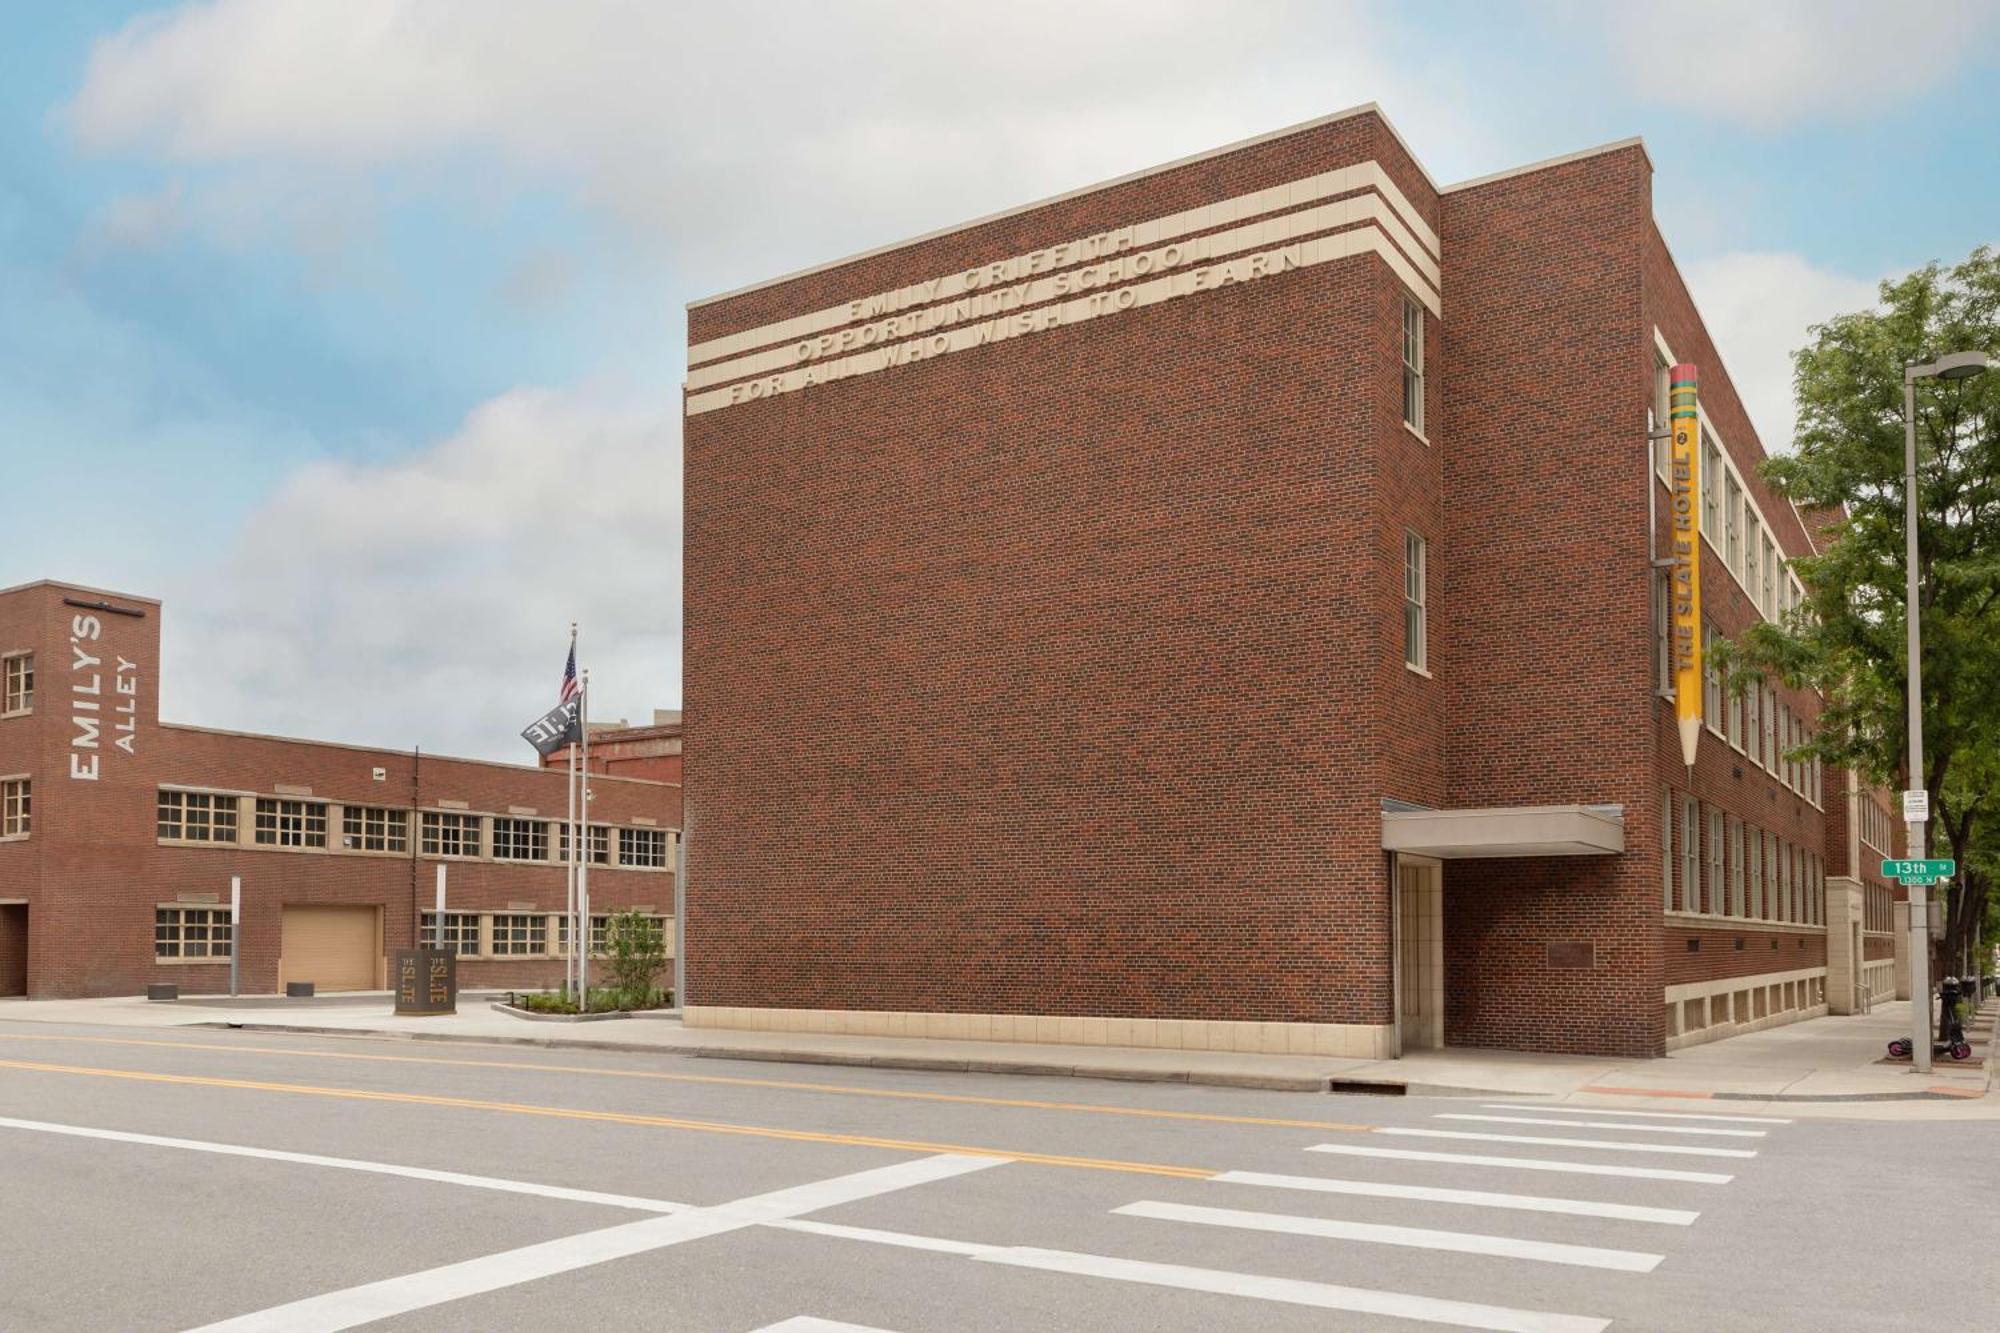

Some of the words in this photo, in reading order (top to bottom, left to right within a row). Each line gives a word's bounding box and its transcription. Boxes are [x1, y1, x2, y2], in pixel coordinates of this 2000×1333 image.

[728, 376, 784, 406] FOR
[801, 357, 859, 387] ALL
[881, 335, 949, 367] WHO
[973, 303, 1066, 344] WISH
[1090, 290, 1135, 316] TO
[1168, 244, 1301, 299] LEARN
[797, 281, 1032, 361] OPPORTUNITY
[1055, 238, 1210, 296] SCHOOL
[849, 279, 942, 321] EMILY
[1672, 451, 1692, 532] HOTEL
[1673, 540, 1694, 617] SLATE
[1675, 625, 1694, 671] THE
[70, 614, 101, 781] EMILY'S
[115, 655, 136, 754] ALLEY
[1895, 862, 1927, 874] 13th
